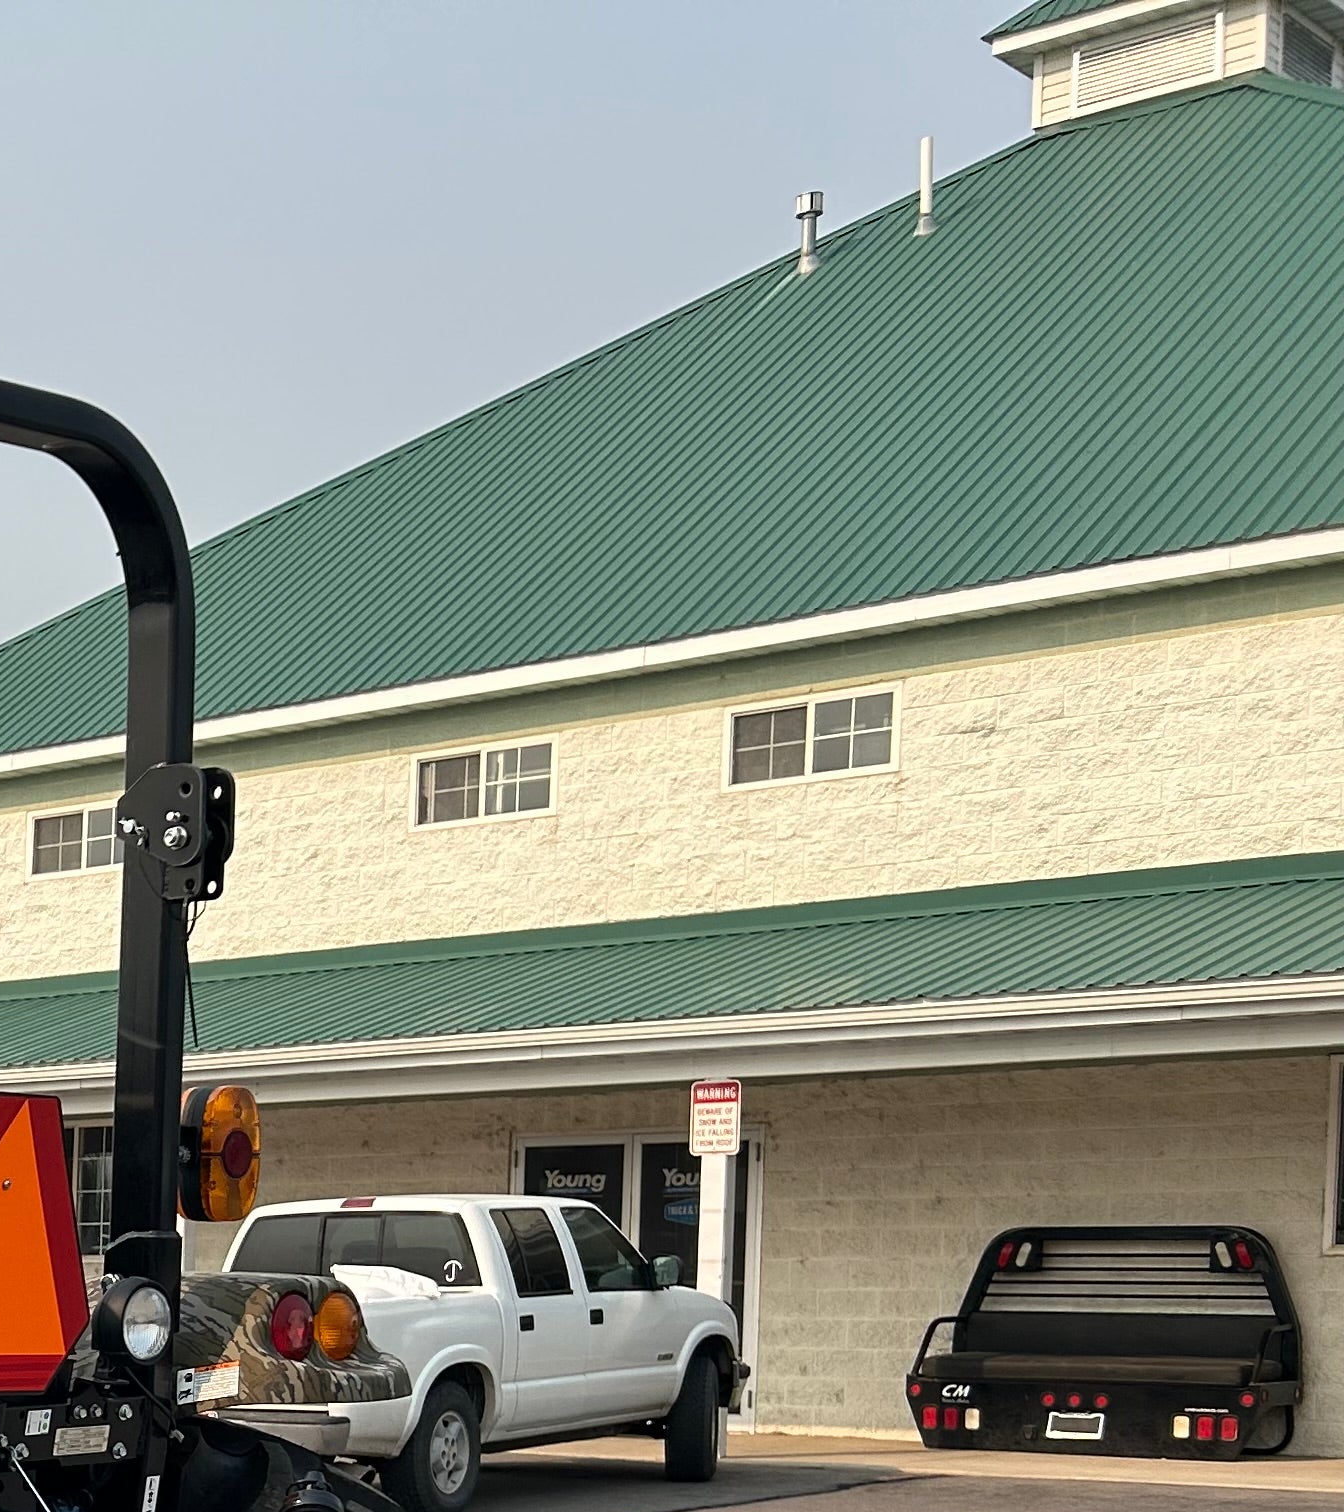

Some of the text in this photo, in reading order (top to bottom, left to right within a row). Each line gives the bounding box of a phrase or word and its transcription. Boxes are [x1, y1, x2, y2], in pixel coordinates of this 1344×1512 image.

[696, 1087, 737, 1100] WARNING
[697, 1107, 734, 1116] BEWARE OF
[544, 1169, 607, 1193] Young
[662, 1167, 699, 1187] You
[942, 1384, 970, 1398] CM
